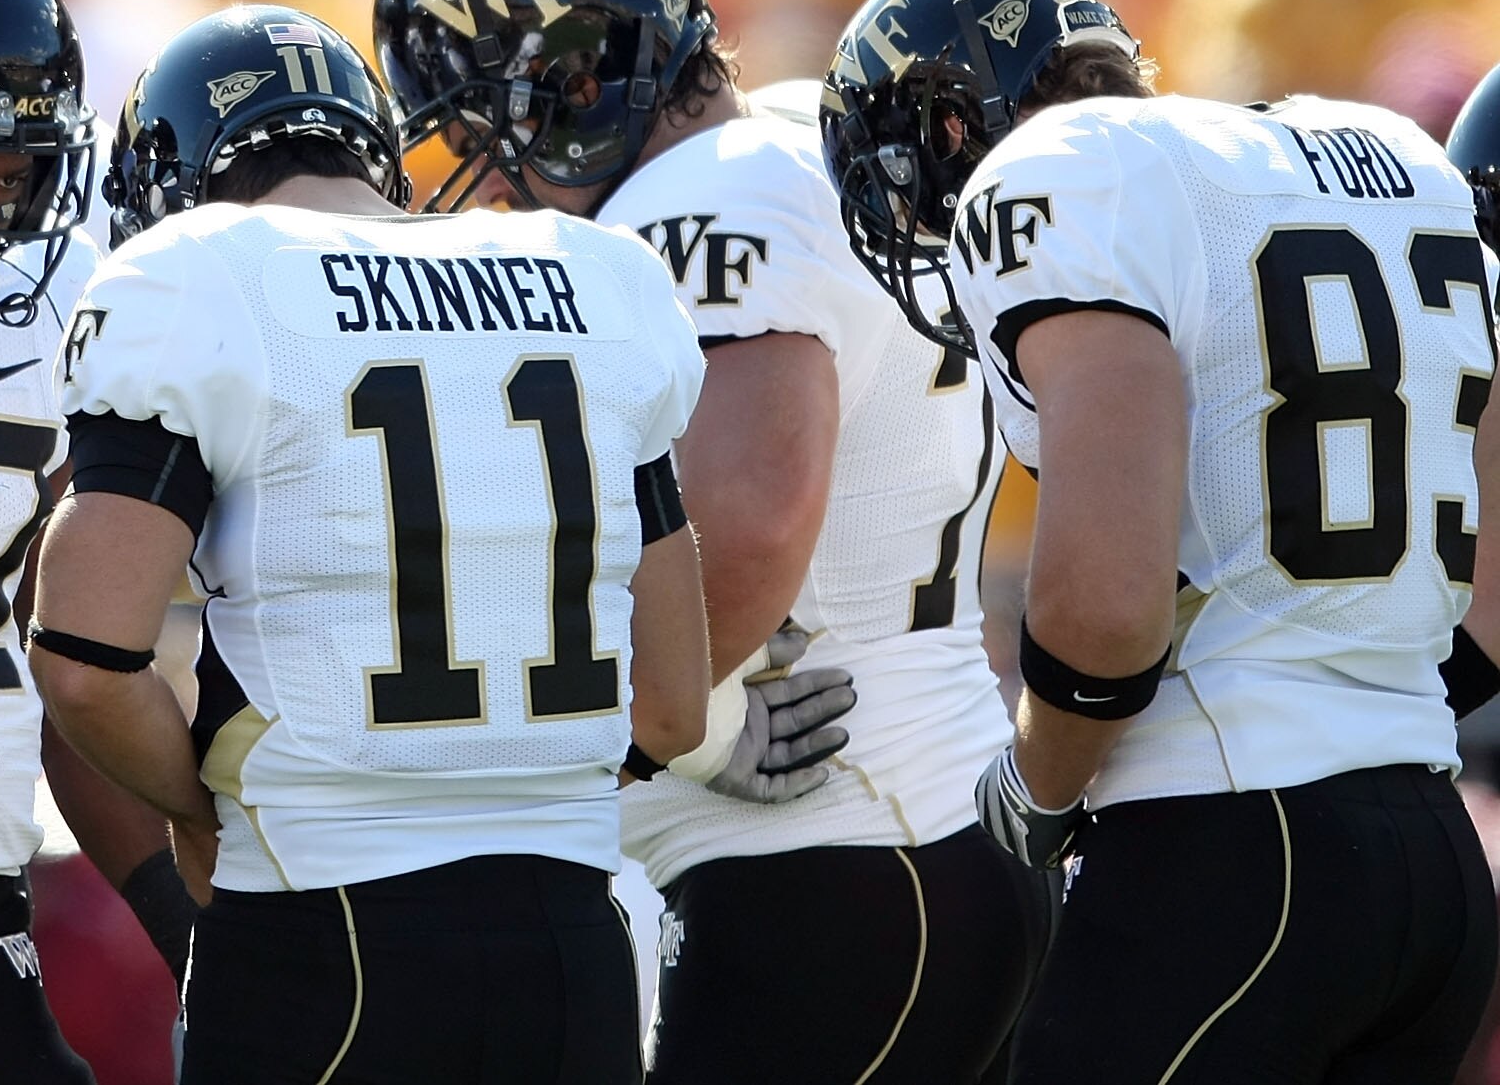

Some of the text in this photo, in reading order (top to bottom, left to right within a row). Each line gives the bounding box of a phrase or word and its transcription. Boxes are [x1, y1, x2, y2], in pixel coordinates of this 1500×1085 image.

[997, 5, 1024, 30] ACC
[1066, 12, 1098, 24] WAKE
[15, 97, 53, 116] ACC
[218, 75, 254, 99] ACC
[276, 46, 334, 94] 11
[1281, 123, 1415, 198] FORD
[635, 212, 770, 309] WF
[955, 178, 1055, 281] WF
[322, 253, 589, 335] SKINNER
[1250, 223, 1496, 590] 83
[344, 352, 622, 731] 11
